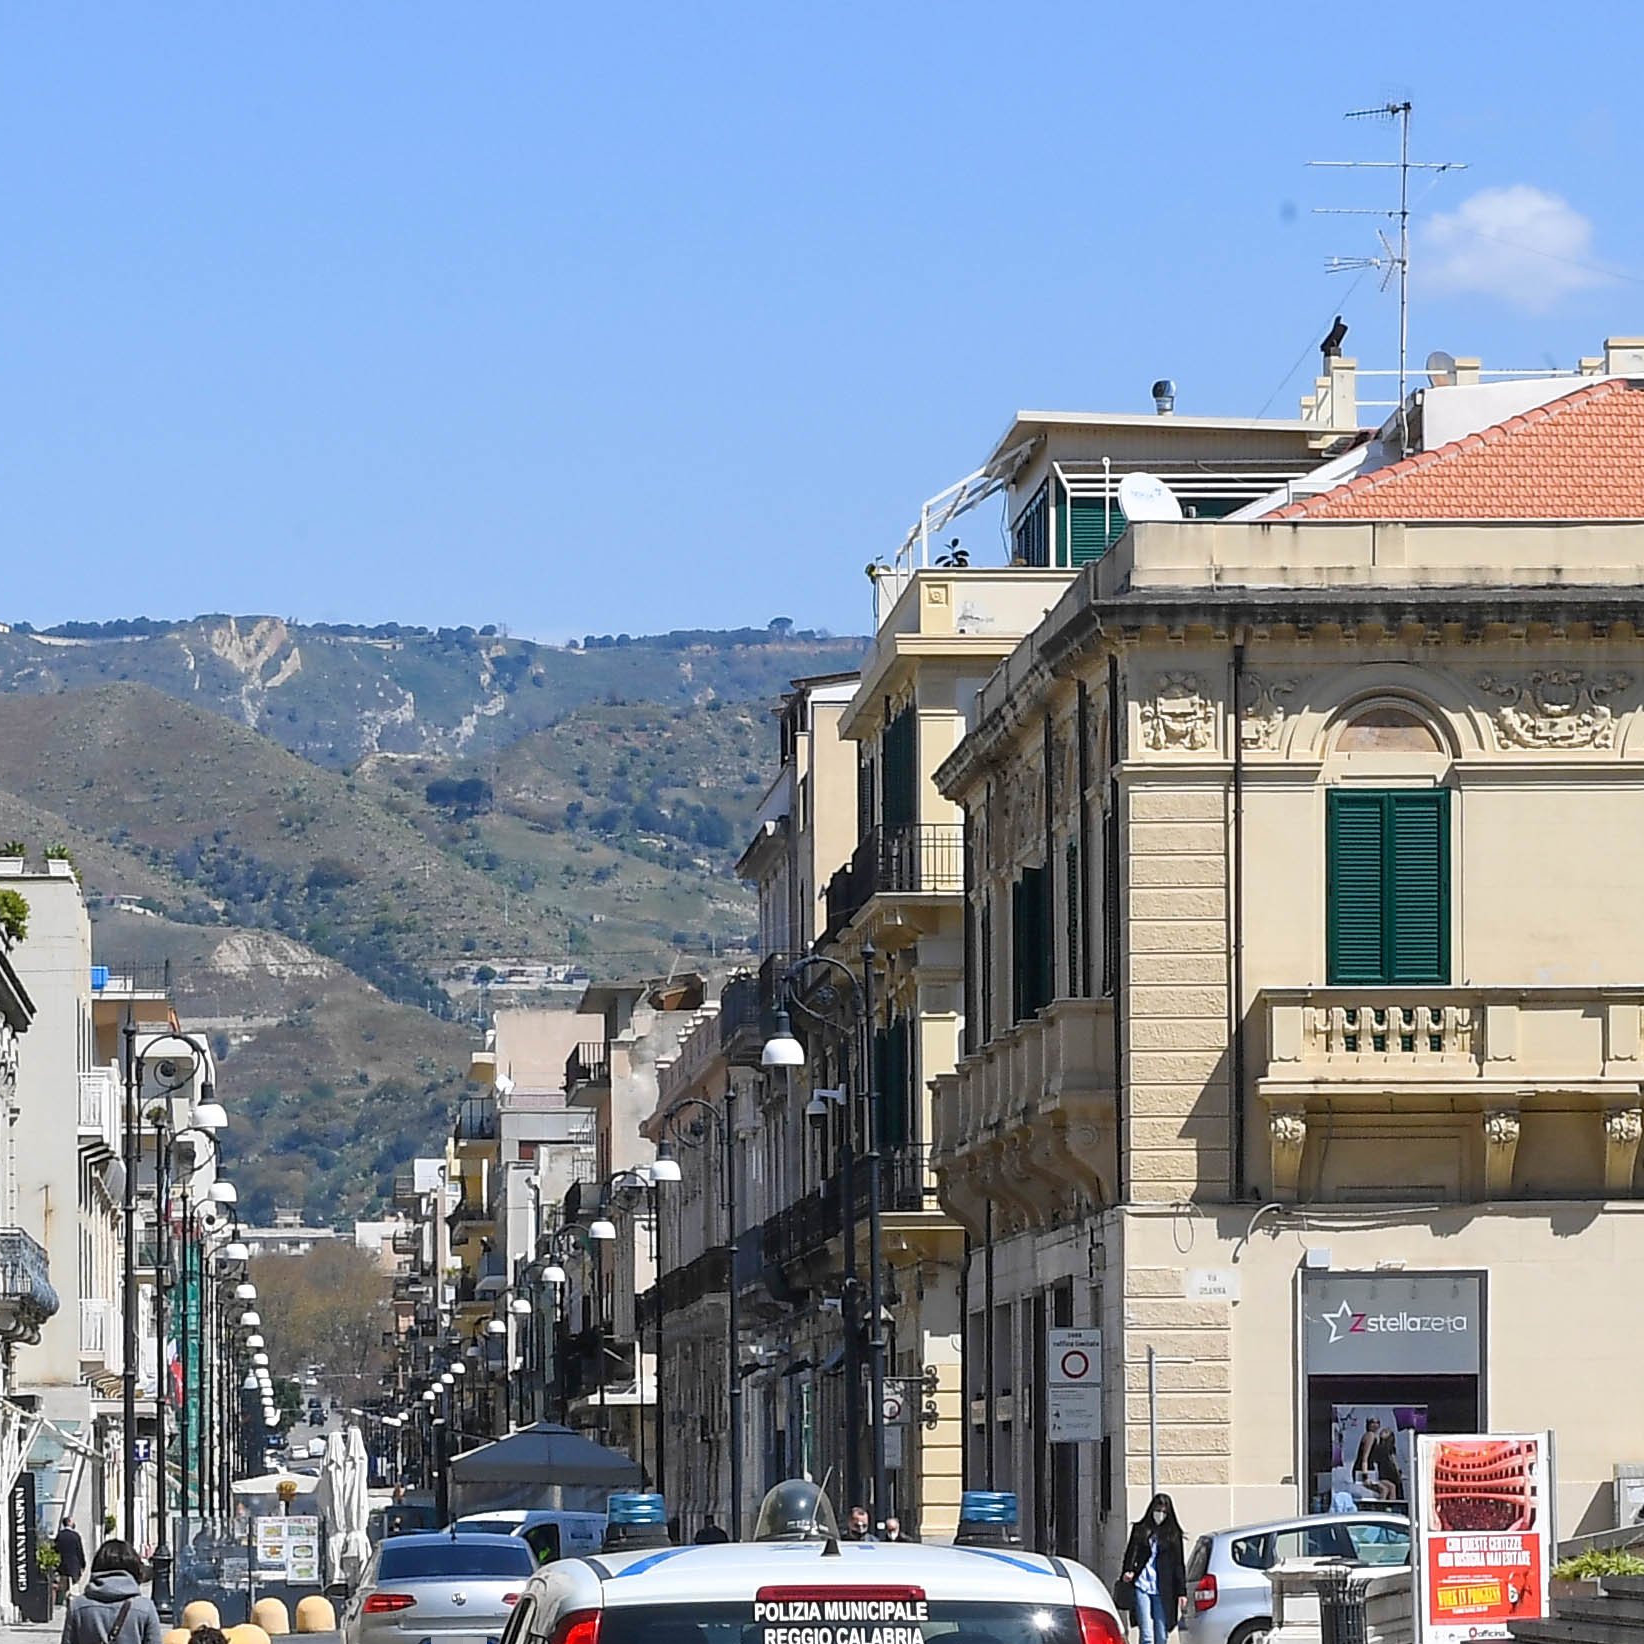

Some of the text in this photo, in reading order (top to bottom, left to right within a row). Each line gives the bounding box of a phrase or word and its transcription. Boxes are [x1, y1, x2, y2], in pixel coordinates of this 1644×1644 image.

[1367, 1312, 1468, 1334] stellazeta
[754, 1601, 929, 1622] POLIZIA MUNICIPALE
